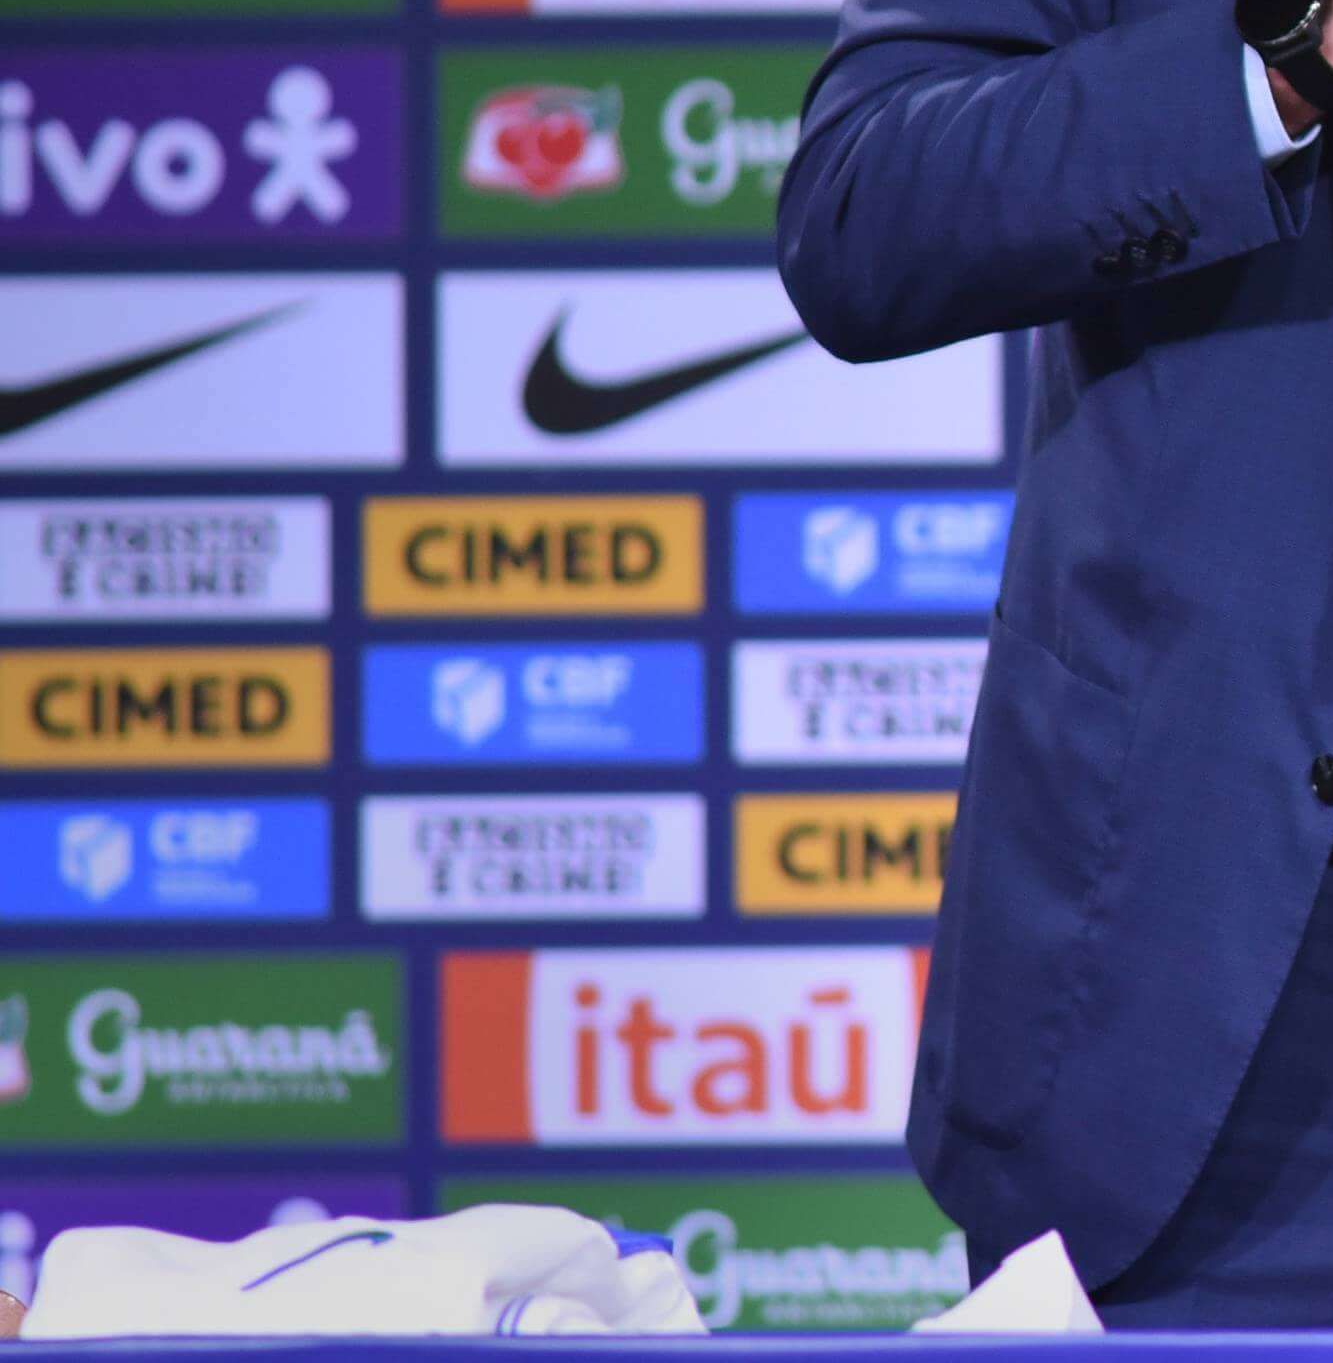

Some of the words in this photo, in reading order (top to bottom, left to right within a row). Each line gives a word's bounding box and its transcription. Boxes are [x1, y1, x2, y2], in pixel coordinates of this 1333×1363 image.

[0, 82, 225, 214] ivo
[401, 523, 663, 588] CIMED
[28, 675, 291, 741] CIMED
[778, 822, 952, 886] CIM
[66, 988, 388, 1114] Guaraná
[573, 982, 867, 1120] itaú
